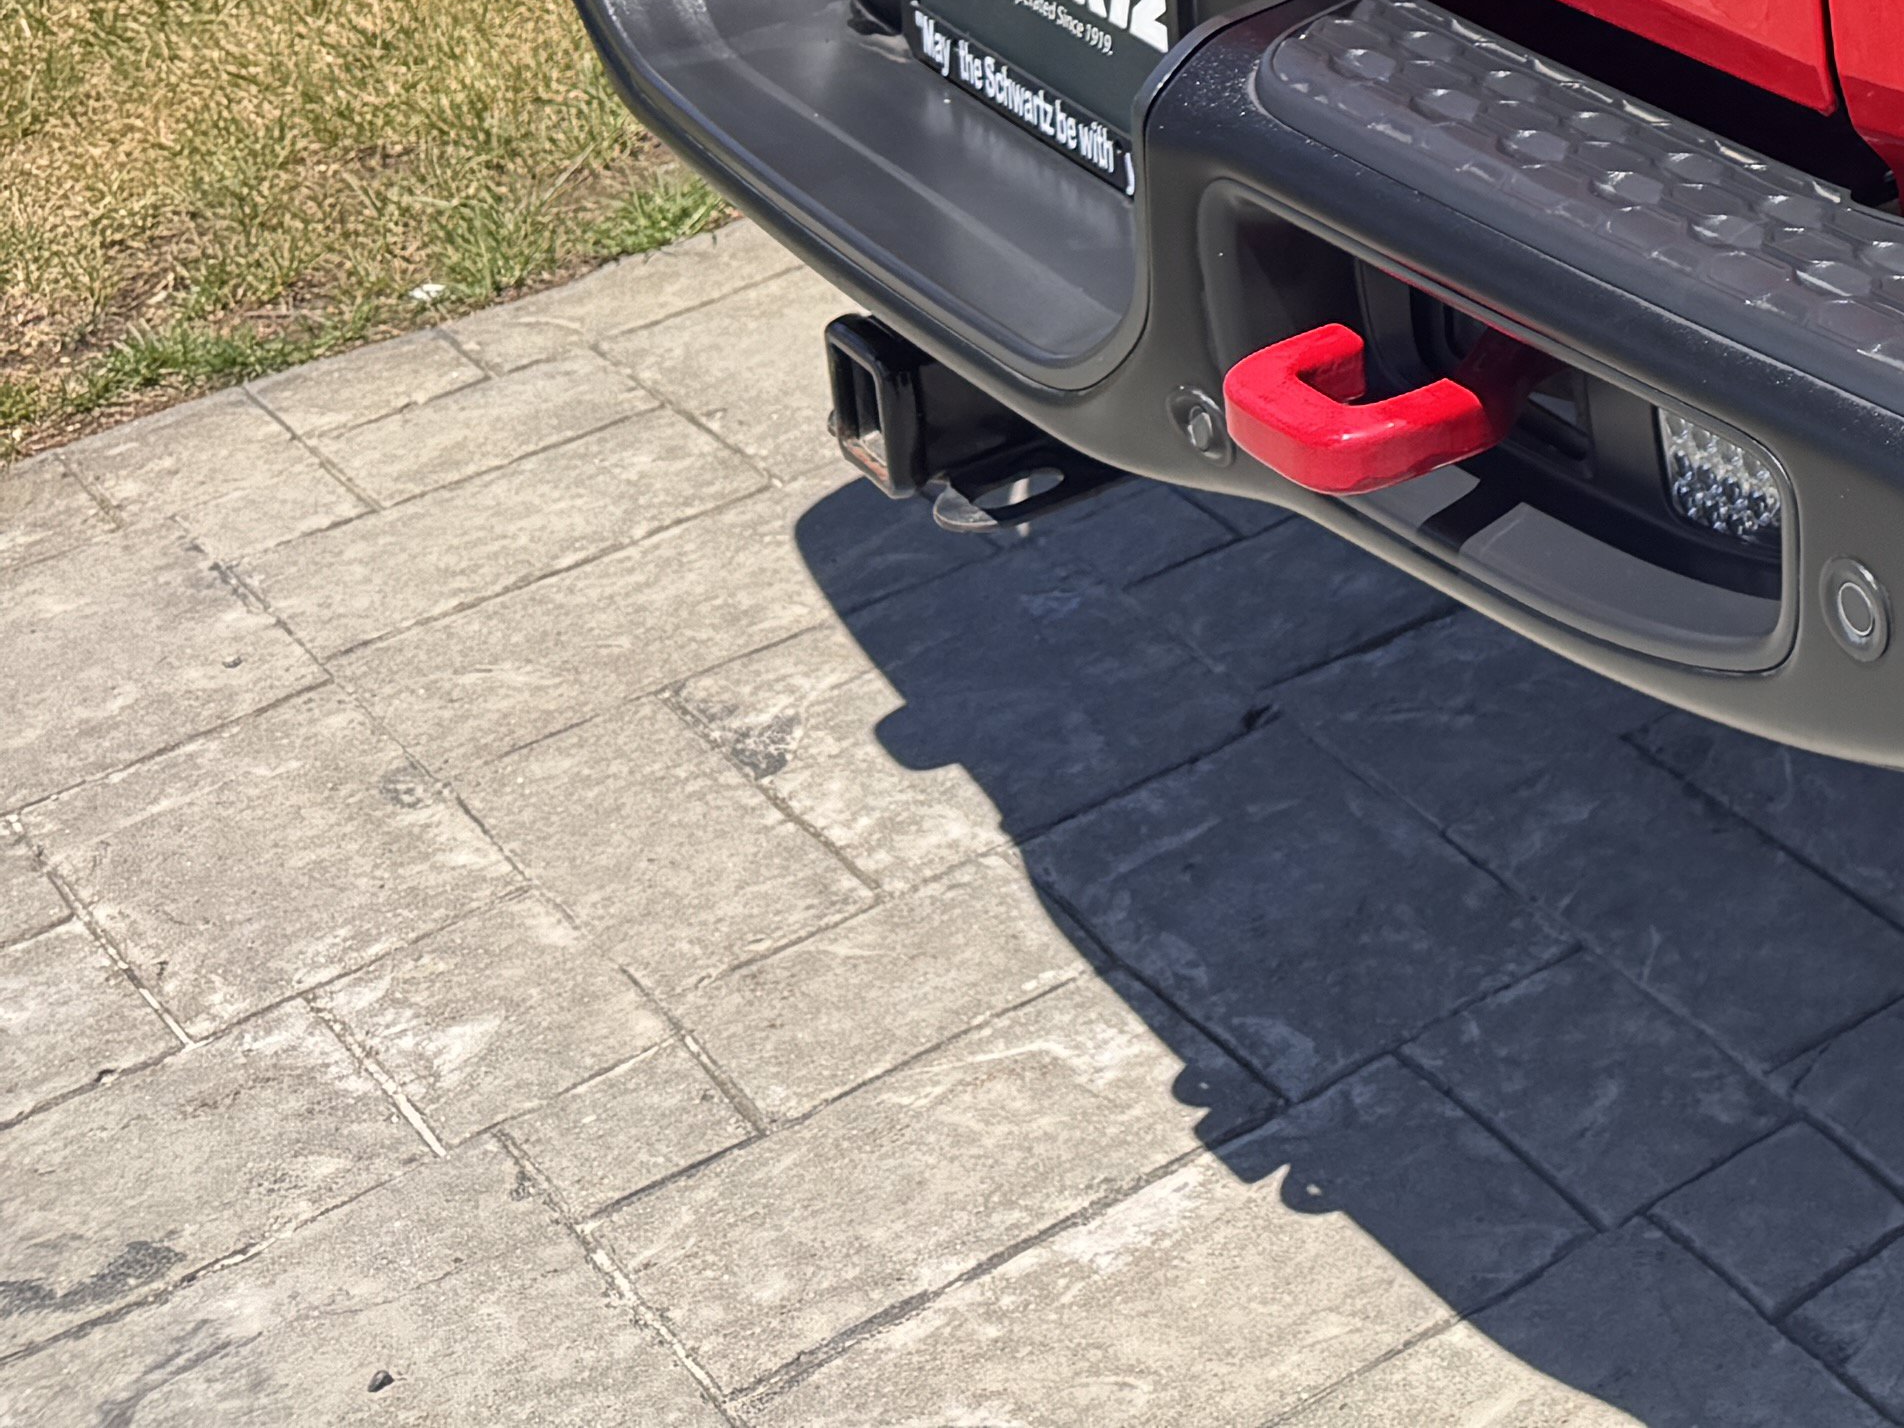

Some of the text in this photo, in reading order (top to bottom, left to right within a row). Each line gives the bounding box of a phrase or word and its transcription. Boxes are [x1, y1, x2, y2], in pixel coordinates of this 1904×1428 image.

[1056, 4, 1085, 38] Since
[958, 40, 982, 90] the
[983, 56, 1055, 136] Schwartz
[1055, 99, 1077, 149] be
[1078, 121, 1114, 174] with
